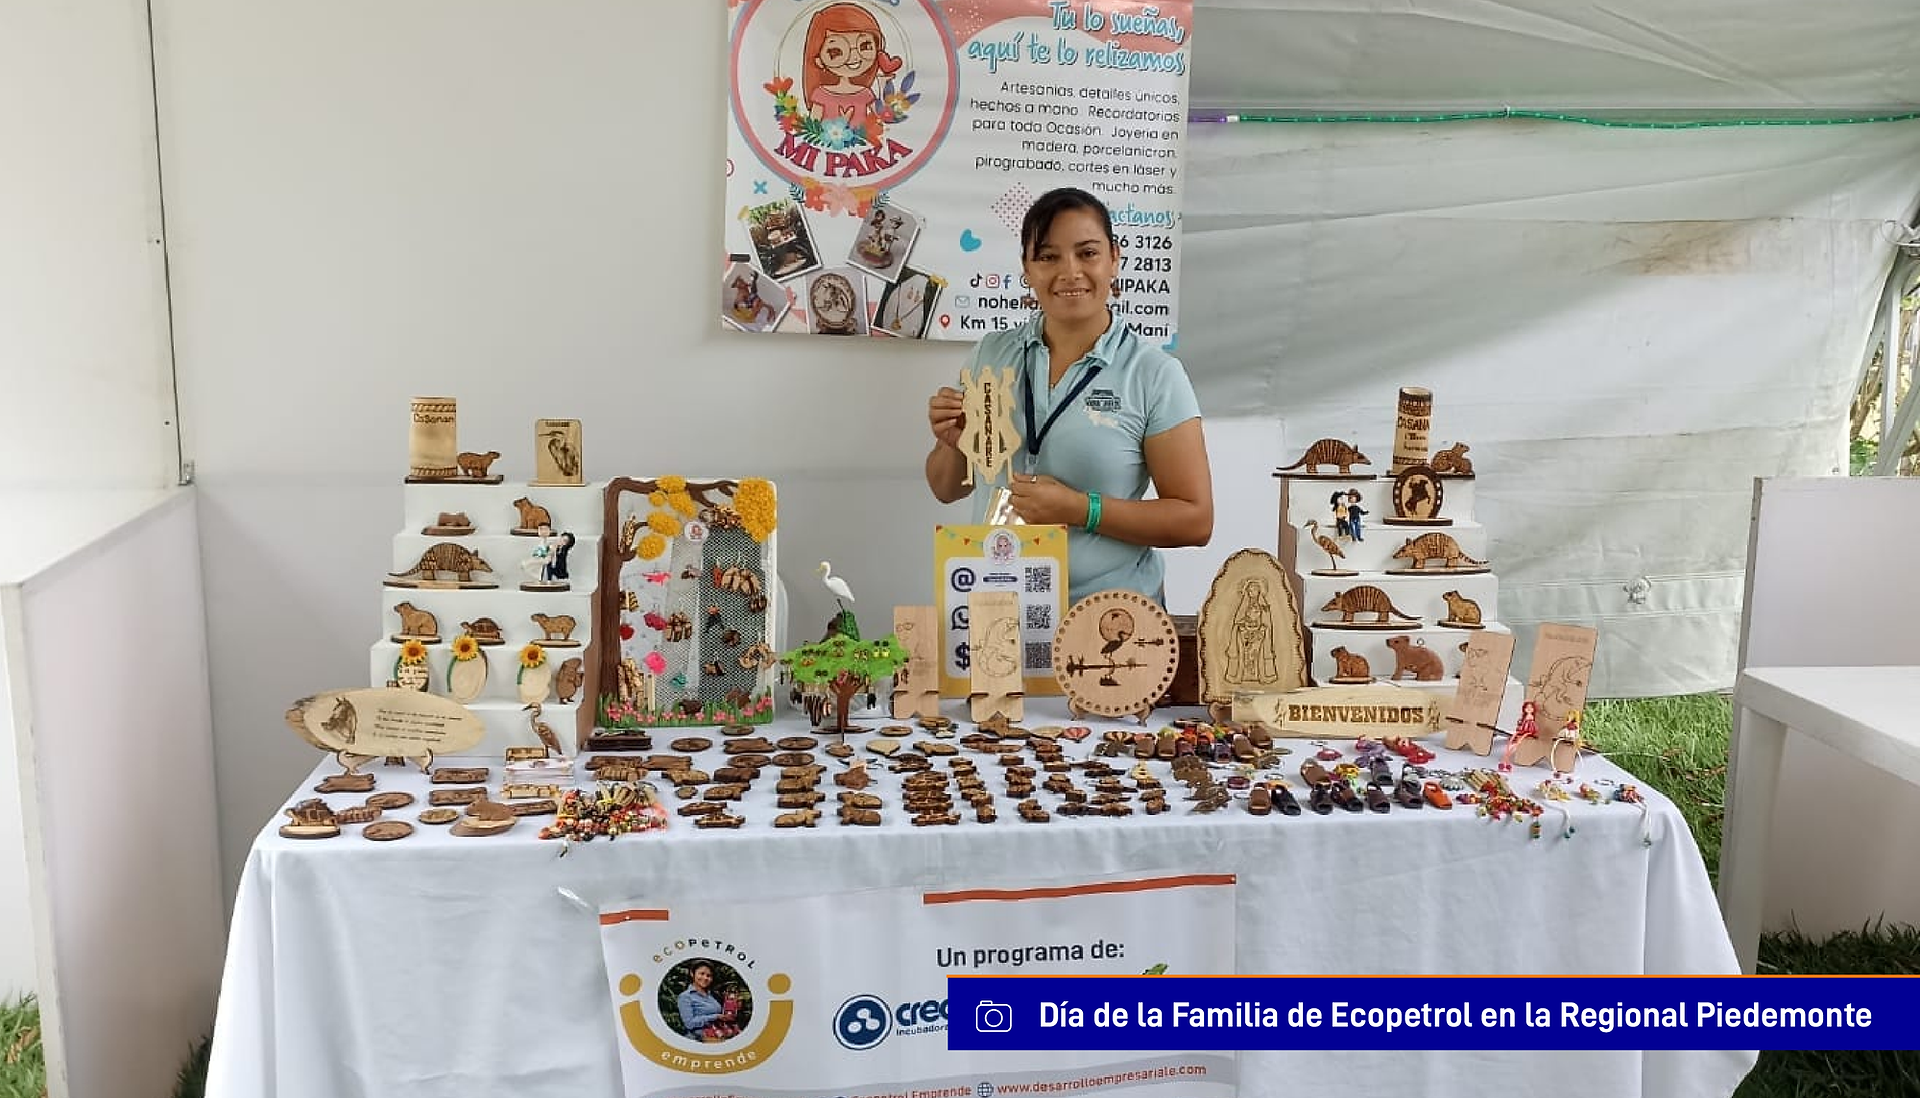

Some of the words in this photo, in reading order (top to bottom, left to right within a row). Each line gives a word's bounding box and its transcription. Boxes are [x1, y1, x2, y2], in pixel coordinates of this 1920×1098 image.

[1049, 1, 1077, 30] Tu
[1084, 4, 1105, 31] lo
[1111, 7, 1184, 43] sueñas,
[967, 31, 1024, 73] aquí
[1027, 32, 1050, 64] te
[1057, 37, 1078, 65] lo
[1085, 41, 1185, 76] relizamos
[970, 98, 1021, 113] hechos
[1025, 103, 1034, 114] a
[972, 118, 1006, 132] para
[1162, 131, 1179, 141] en
[774, 132, 821, 172] MI
[824, 138, 914, 178] PAKA
[1068, 161, 1110, 174] cortes
[1113, 164, 1129, 175] en
[1169, 167, 1178, 178] y
[1092, 181, 1138, 194] mucho
[1135, 235, 1173, 250] 3126
[1134, 256, 1172, 273] 2813
[960, 315, 986, 330] Km
[991, 316, 1009, 331] 15
[1288, 704, 1424, 723] BIENVENIDOS
[936, 946, 967, 967] Un
[973, 944, 1085, 968] programa
[1091, 939, 1125, 959] de:
[661, 1050, 757, 1071] emprende
